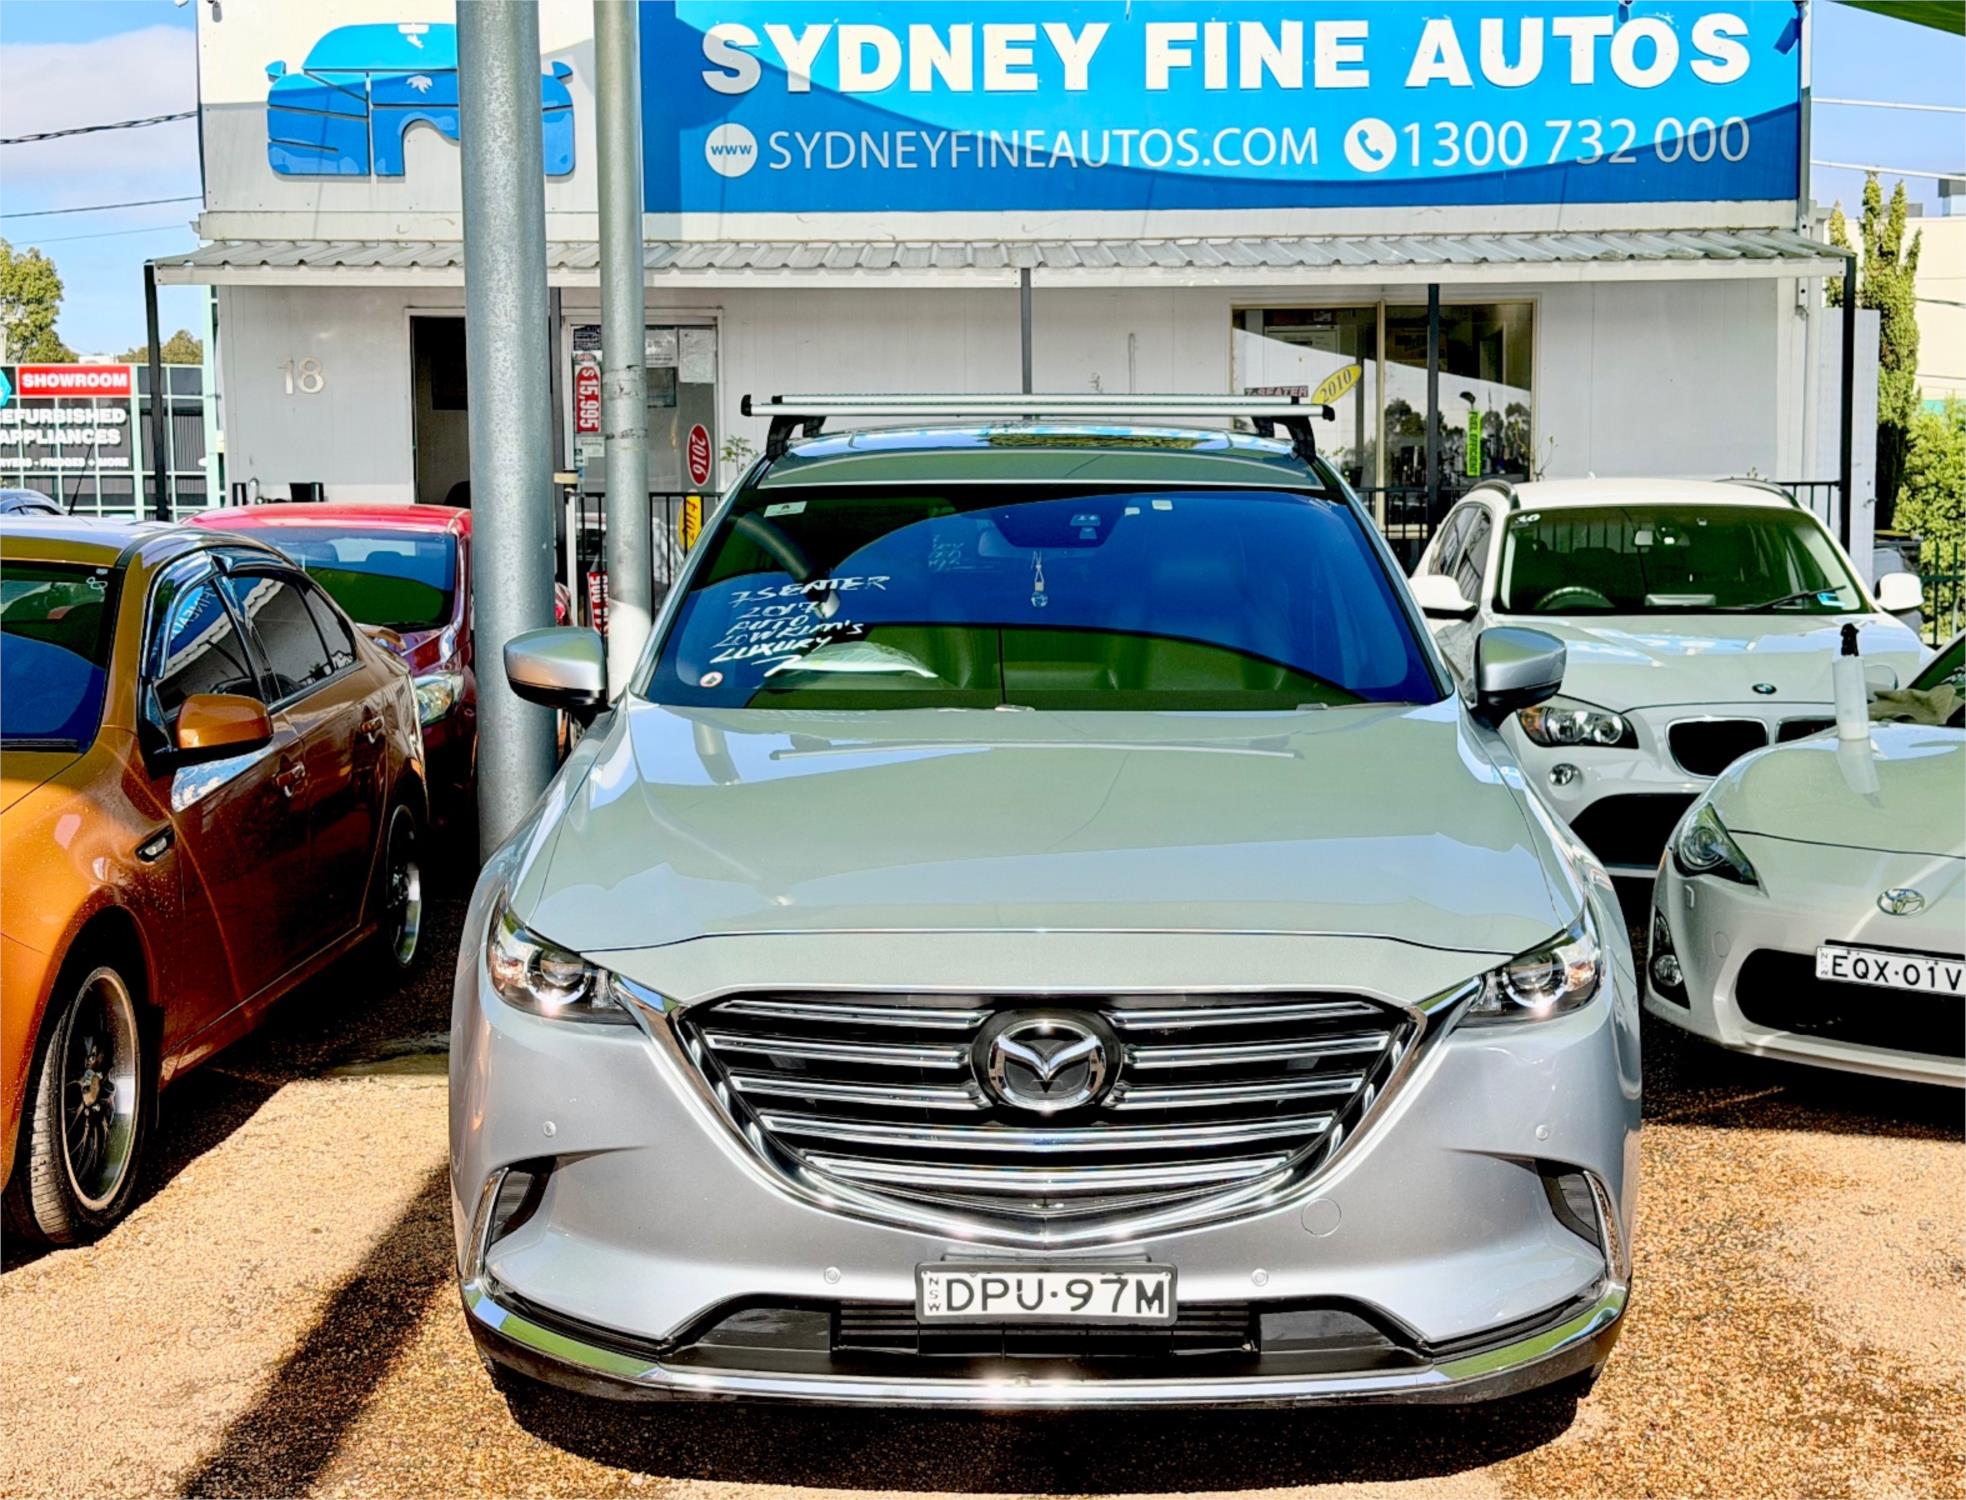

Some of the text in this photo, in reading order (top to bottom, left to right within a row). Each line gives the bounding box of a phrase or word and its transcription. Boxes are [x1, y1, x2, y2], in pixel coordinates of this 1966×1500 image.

[702, 12, 1751, 94] SYDNEY FINE AUTOS
[711, 145, 752, 156] www
[769, 127, 1318, 170] SYDNEYFINEAUTOS.COM
[1402, 116, 1750, 167] 1300 732 000
[22, 373, 128, 388] SHOWROOM
[278, 357, 324, 394] 18
[1321, 368, 1352, 402] 2010
[0, 408, 127, 424] EFURBISHED
[579, 369, 599, 428] $15,995
[98, 457, 129, 467] MORE
[692, 434, 707, 477] 2016
[709, 636, 833, 664] LUXURY
